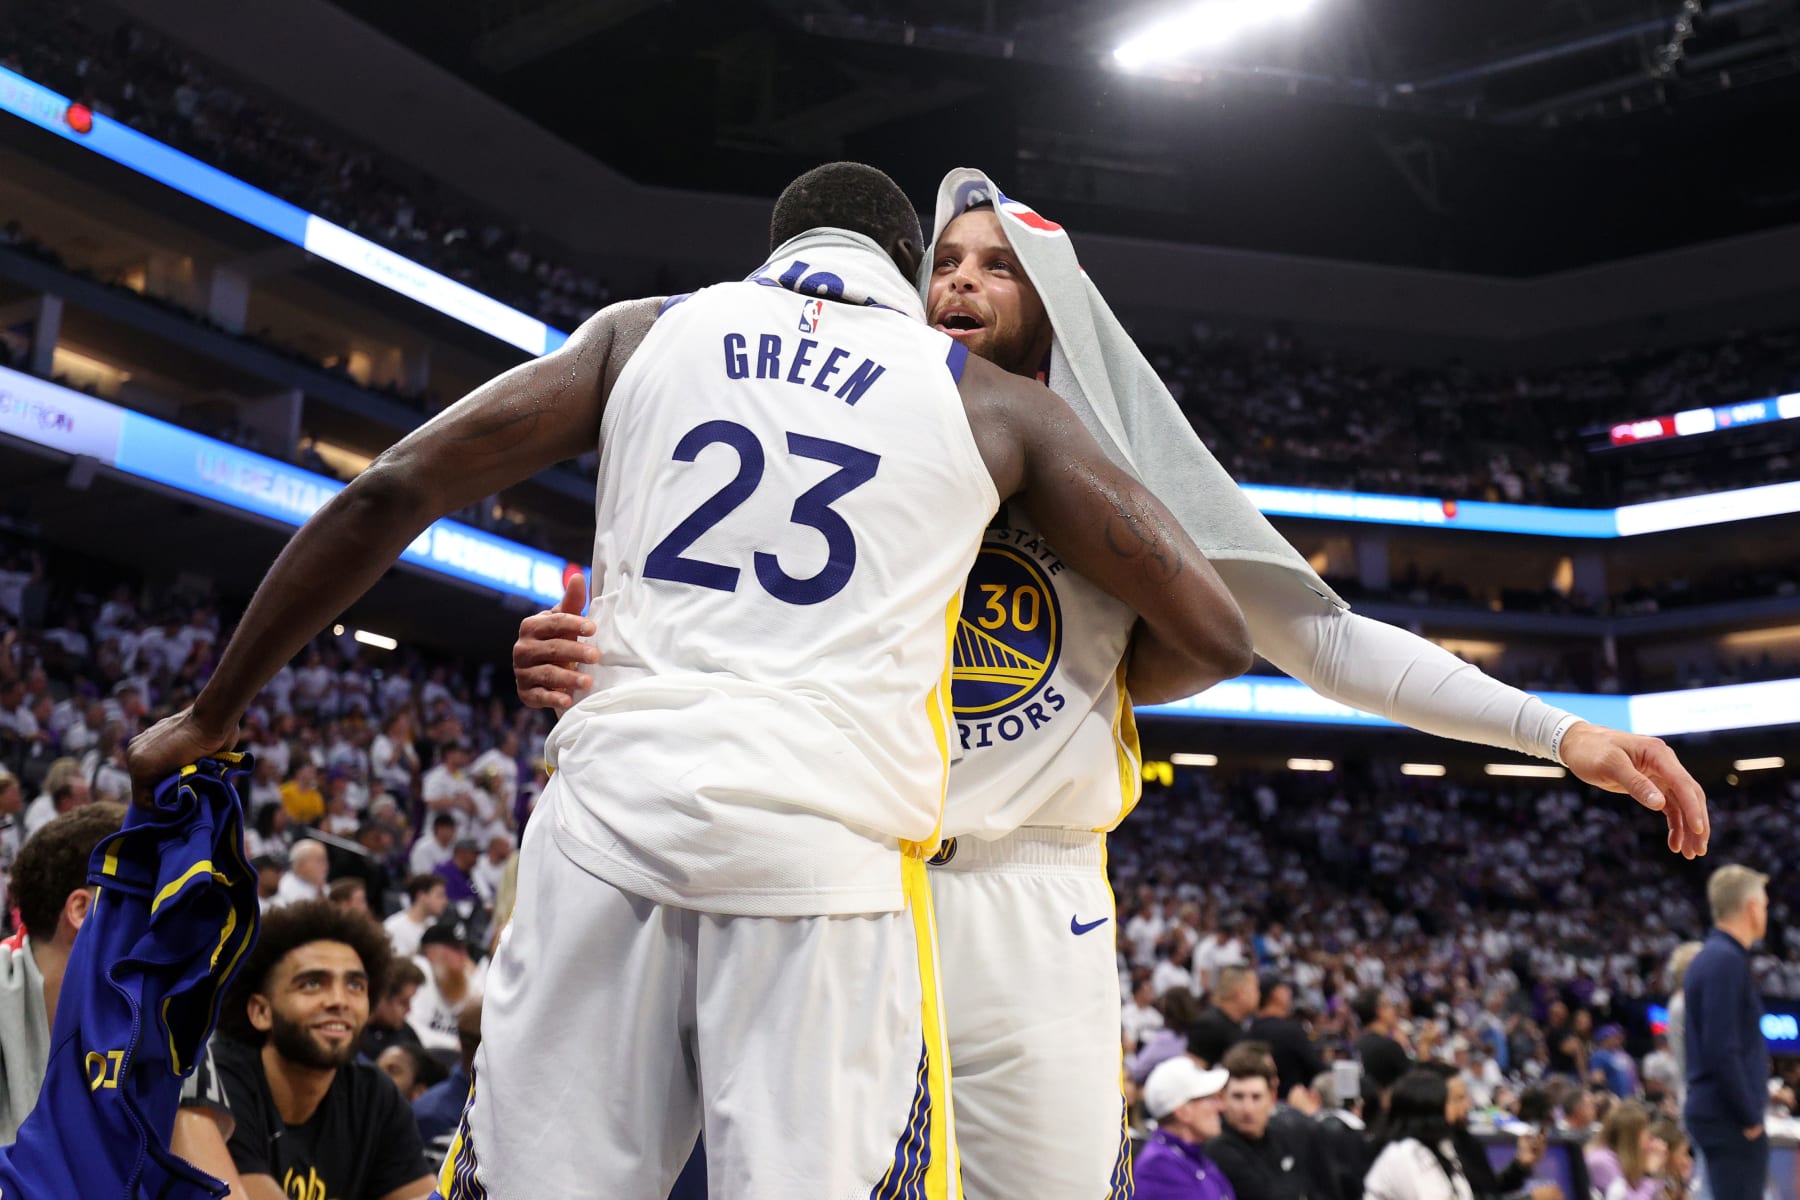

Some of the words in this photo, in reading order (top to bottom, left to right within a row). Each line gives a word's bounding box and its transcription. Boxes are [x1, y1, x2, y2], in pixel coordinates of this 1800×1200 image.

[723, 333, 886, 406] GREEN
[642, 420, 881, 605] 23
[998, 528, 1065, 576] STATE
[977, 584, 1040, 632] 30
[958, 686, 1066, 750] RIORS
